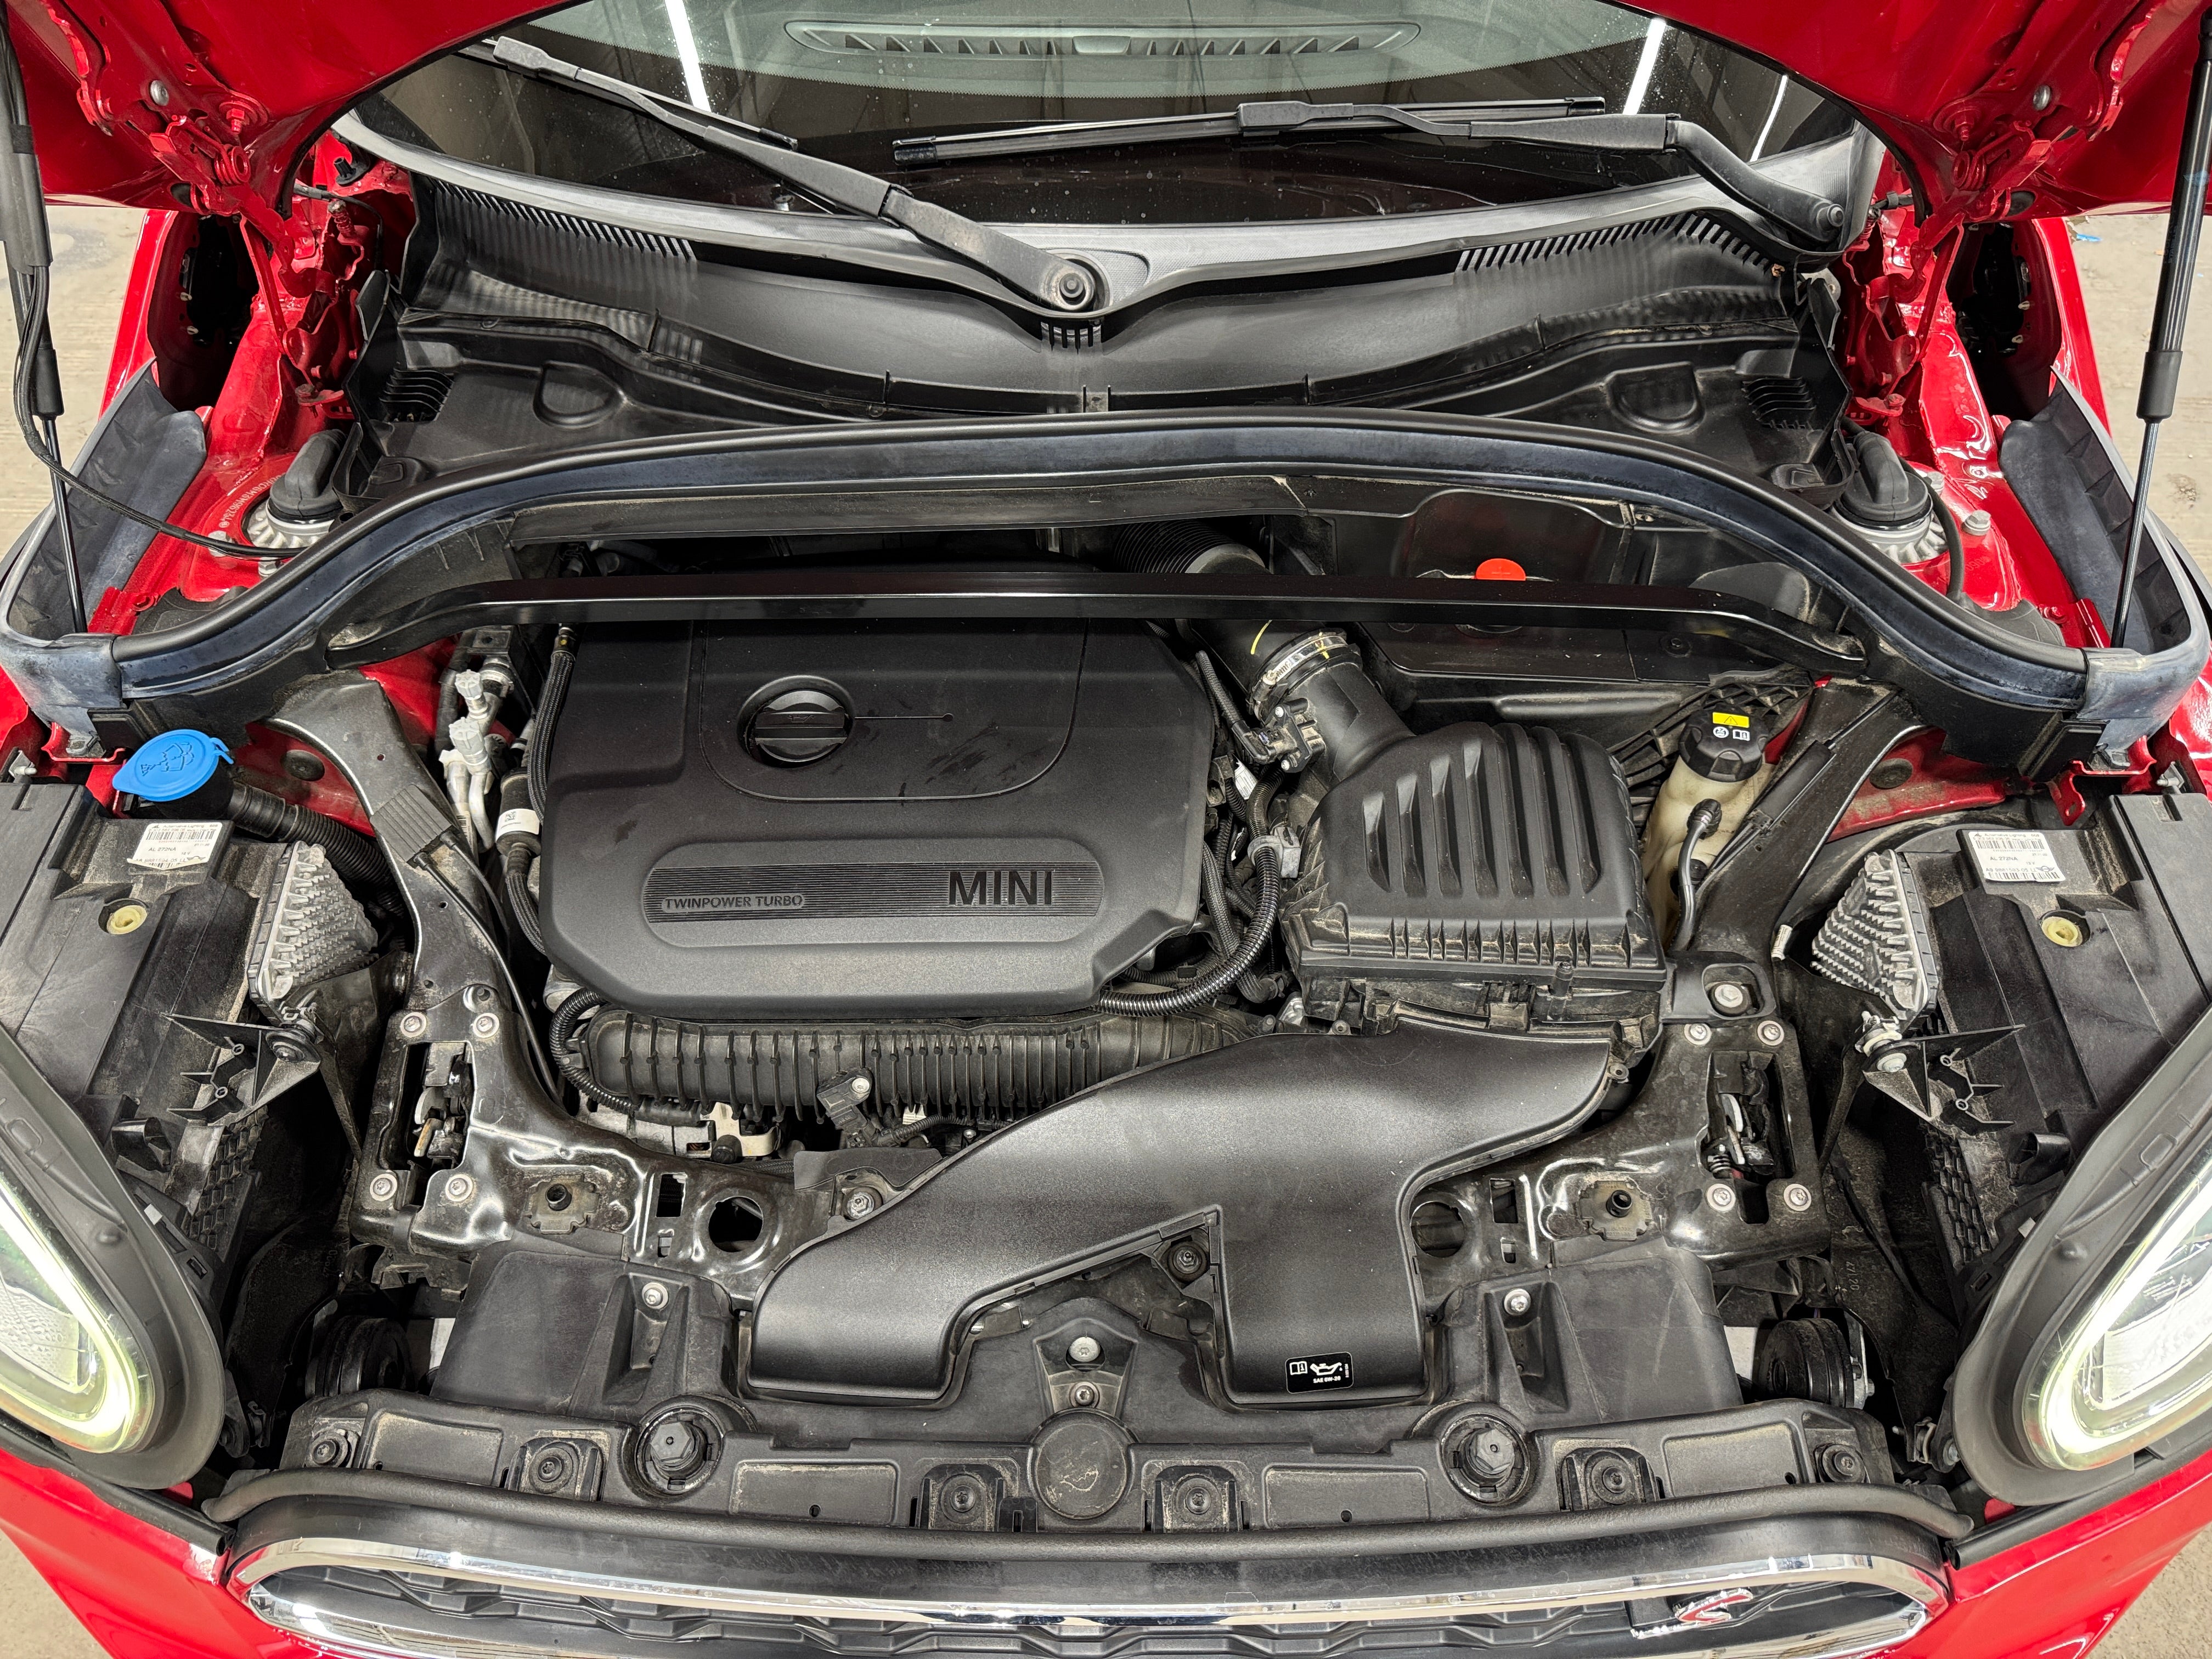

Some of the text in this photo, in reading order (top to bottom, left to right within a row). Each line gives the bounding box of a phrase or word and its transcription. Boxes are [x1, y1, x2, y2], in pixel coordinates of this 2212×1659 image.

[949, 871, 1052, 906] MINI
[665, 895, 803, 909] TWINPOWER TURBO
